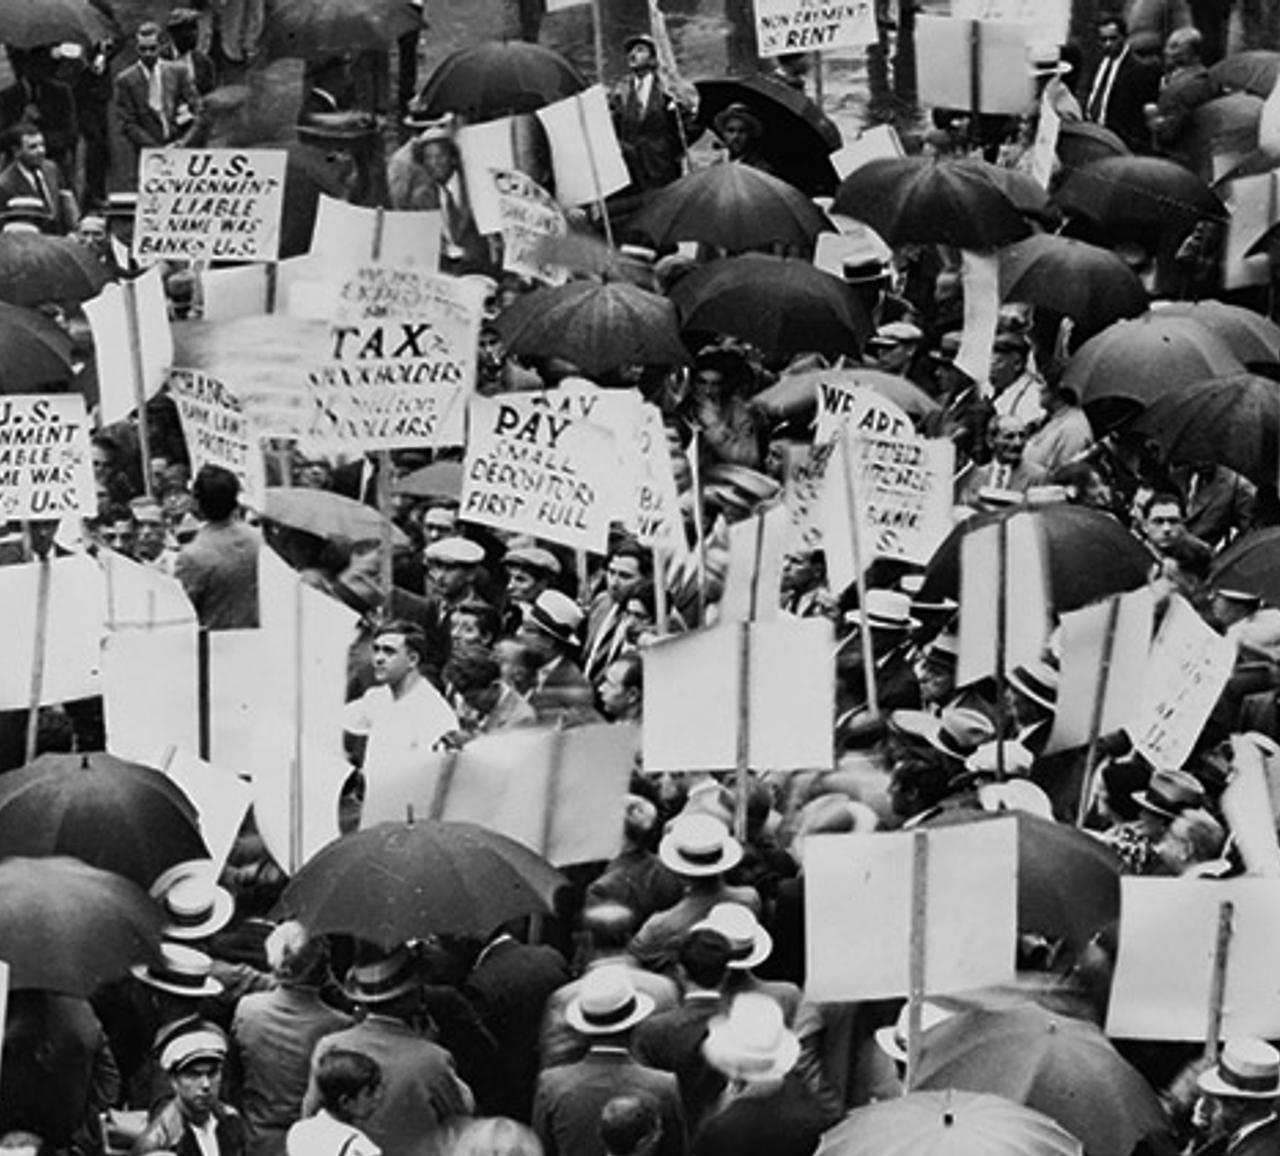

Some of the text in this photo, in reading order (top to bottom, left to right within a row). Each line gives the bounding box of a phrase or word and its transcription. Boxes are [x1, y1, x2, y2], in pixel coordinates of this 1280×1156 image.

[785, 24, 840, 48] RENT
[187, 154, 255, 178] U.S.
[145, 178, 279, 196] GOVERNMENT
[171, 197, 257, 217] LIABLE
[168, 218, 213, 234] NAME
[221, 218, 263, 234] WAS
[213, 237, 258, 256] U.S.
[331, 323, 432, 359] TAX
[821, 383, 855, 414] WE
[494, 405, 572, 448] PAY
[488, 440, 576, 475] SMALL
[30, 466, 76, 485] WAS
[31, 488, 81, 513] U.S.
[465, 490, 588, 530] FIRST FULL
